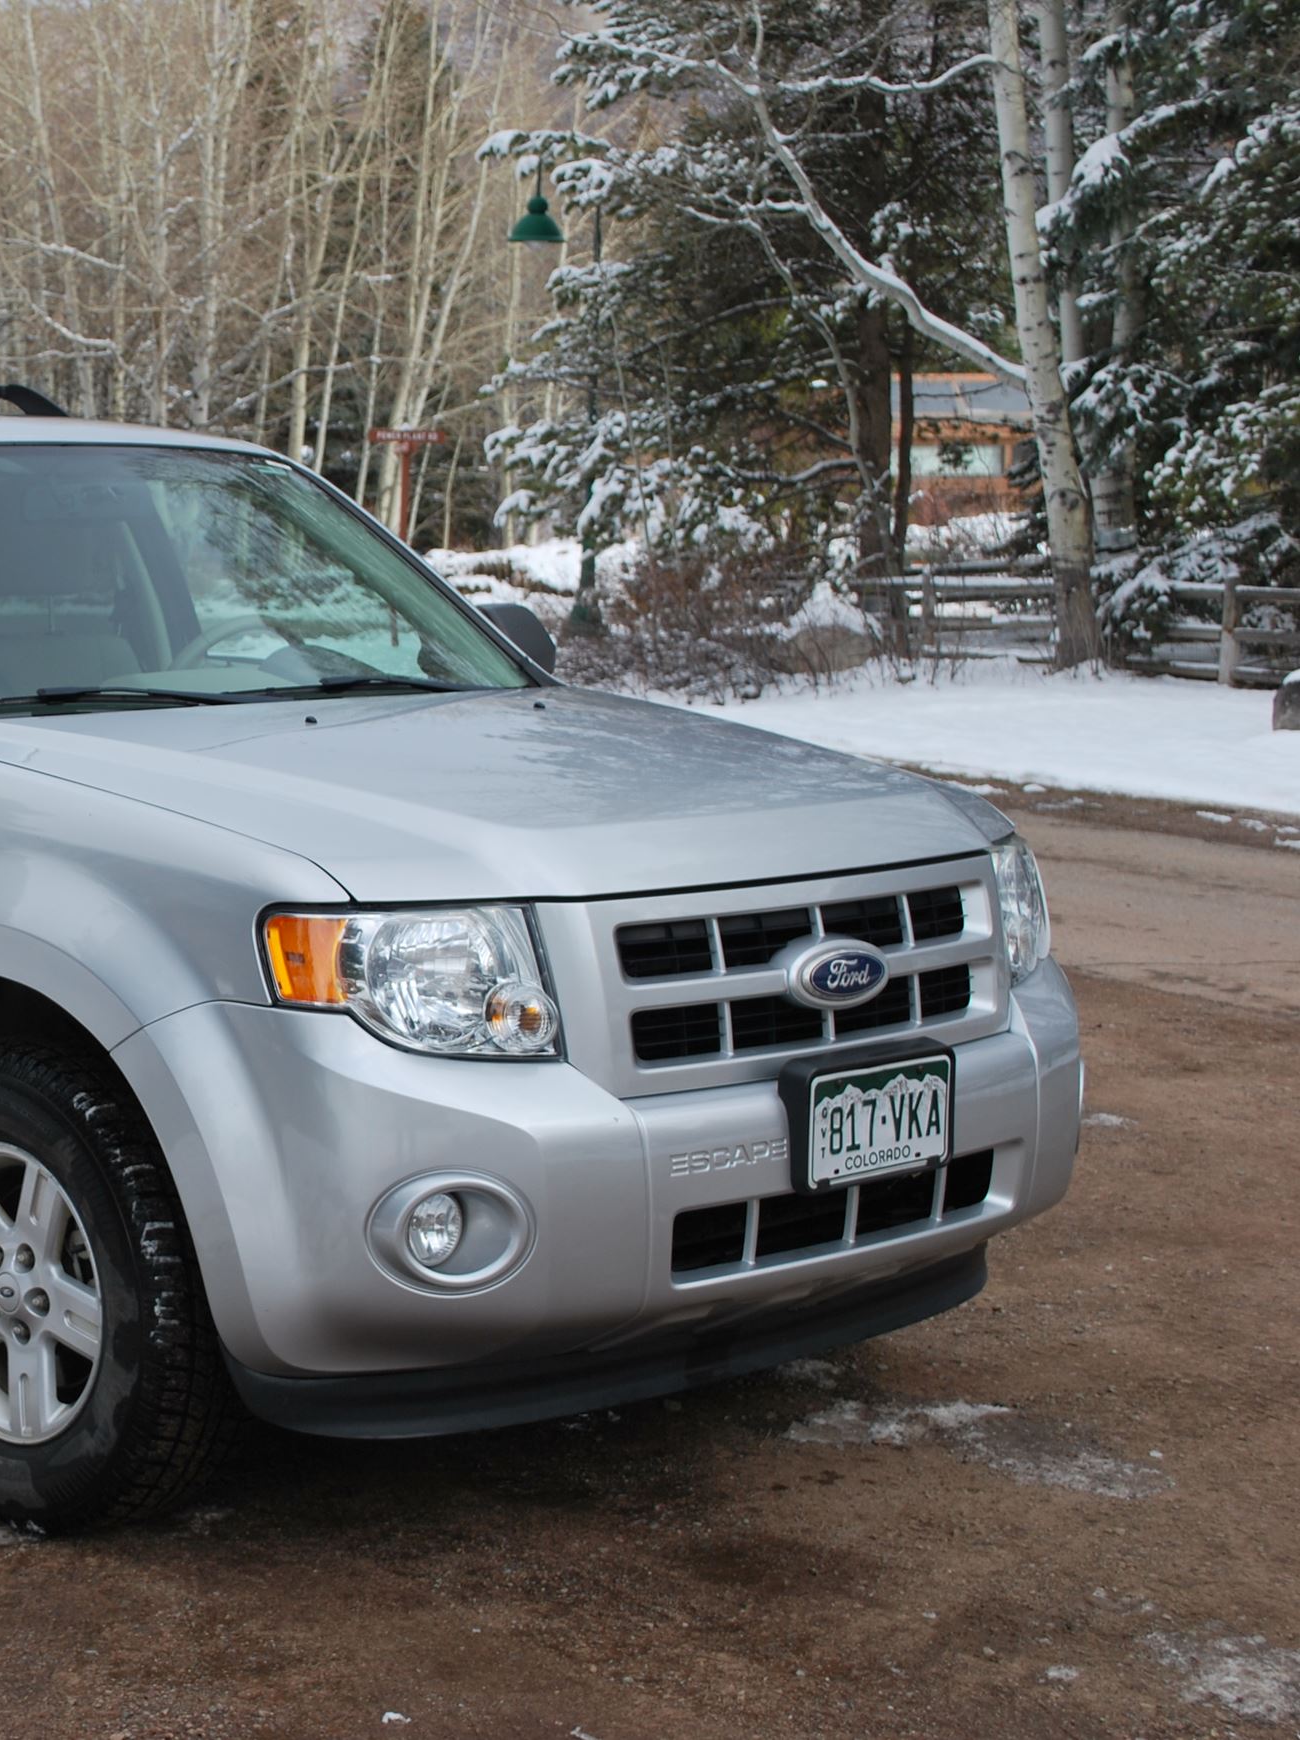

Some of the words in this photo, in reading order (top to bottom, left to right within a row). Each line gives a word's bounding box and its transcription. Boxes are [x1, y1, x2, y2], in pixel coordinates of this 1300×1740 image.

[376, 431, 401, 440] POWER
[403, 432, 427, 441] PLANT
[827, 958, 871, 989] Ford
[670, 1137, 788, 1177] ESCAPE
[845, 1145, 911, 1171] COLORADO
